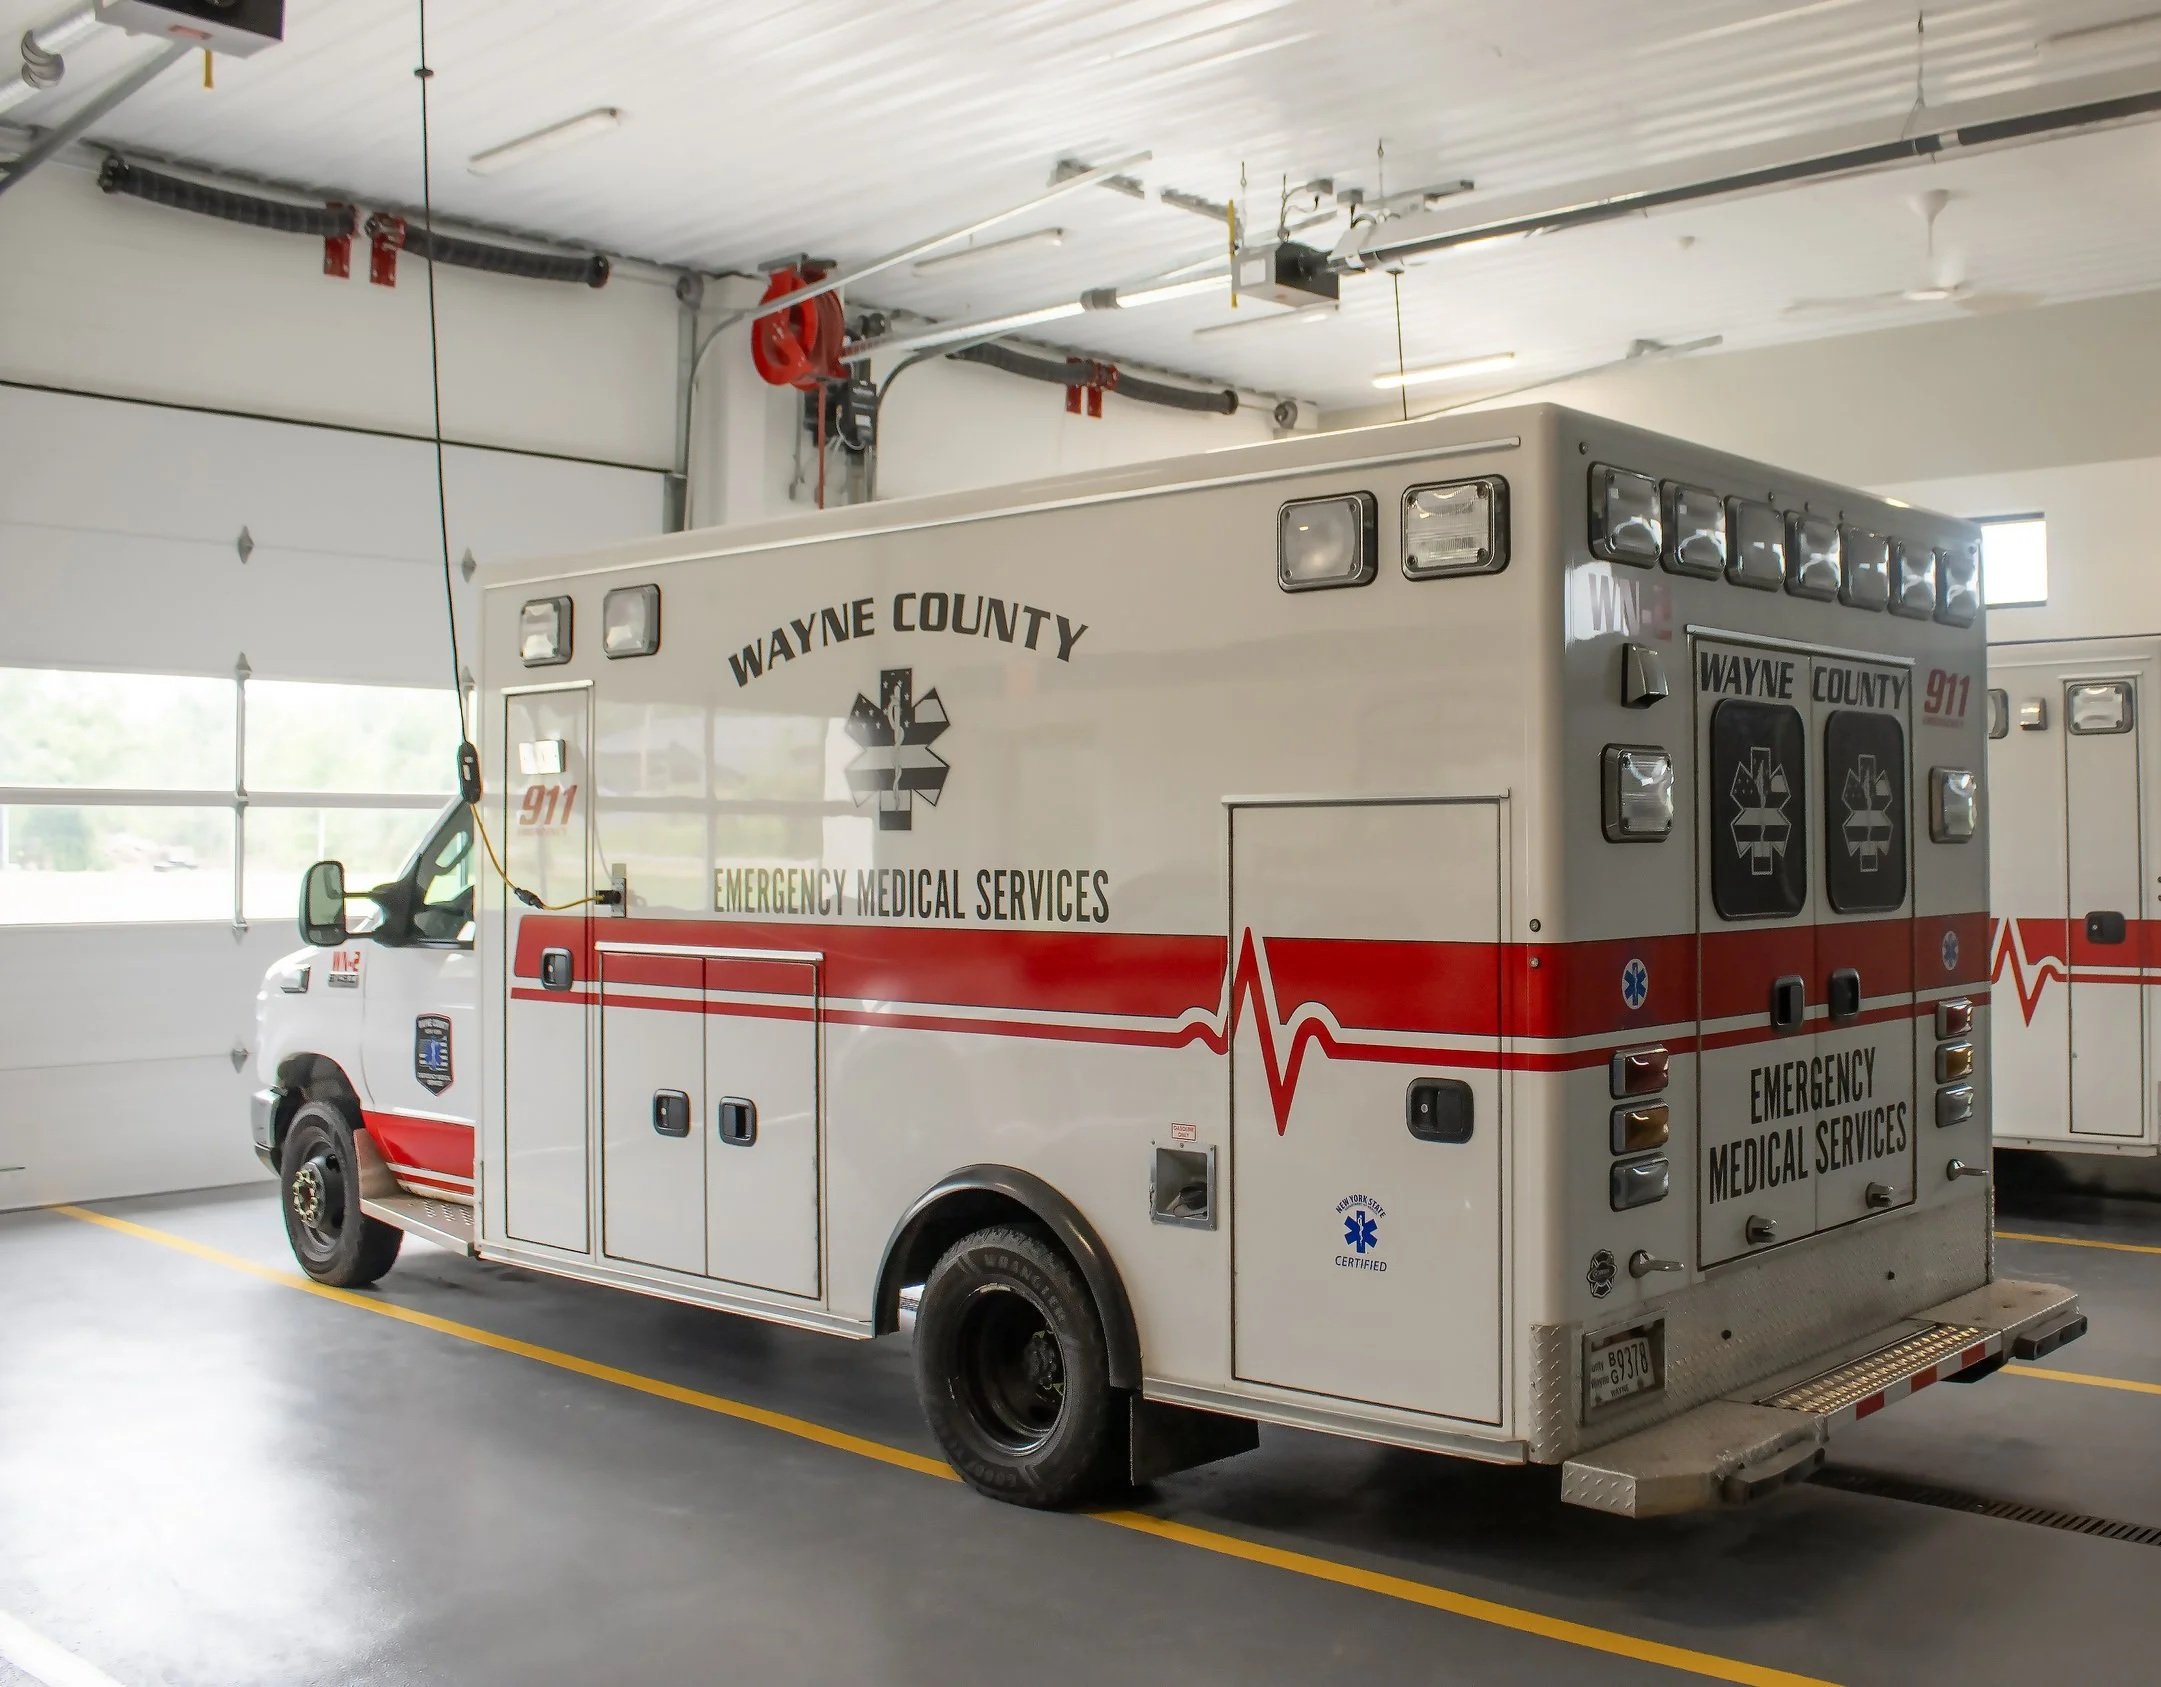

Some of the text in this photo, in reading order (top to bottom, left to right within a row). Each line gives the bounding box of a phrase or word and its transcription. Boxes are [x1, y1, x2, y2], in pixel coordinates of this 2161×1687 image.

[728, 592, 1088, 688] WAYNE COUNTY
[1700, 651, 1908, 710] WAYNE COUNTY
[1924, 669, 1970, 717] 911
[519, 784, 578, 826] 911
[713, 867, 1110, 924] EMERGENCY MEDICAL SERVICES
[1751, 1047, 1876, 1125] EMERGENCY
[1709, 1101, 1907, 1205] MEDICAL SERVICES
[1336, 1198, 1350, 1213] NEW
[1349, 1194, 1367, 1203] YORK
[1368, 1198, 1386, 1218] STATE
[1335, 1255, 1387, 1272] CERTIFIED
